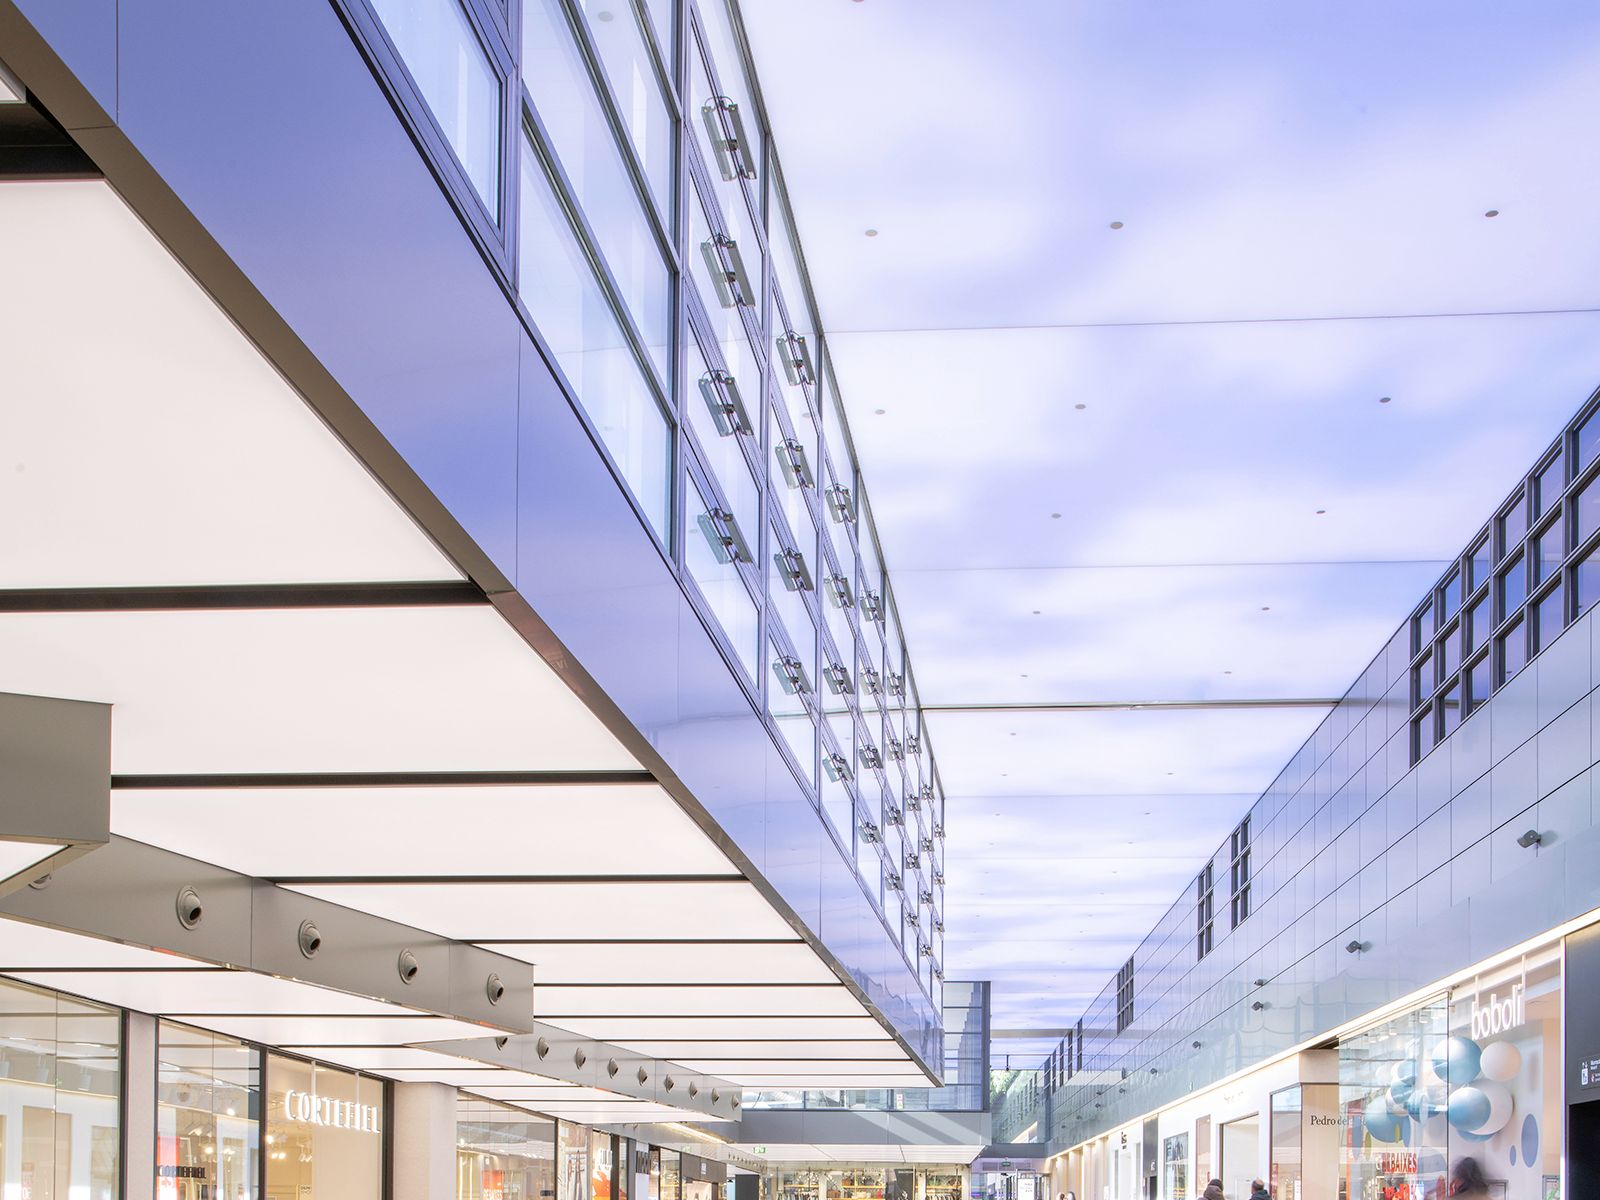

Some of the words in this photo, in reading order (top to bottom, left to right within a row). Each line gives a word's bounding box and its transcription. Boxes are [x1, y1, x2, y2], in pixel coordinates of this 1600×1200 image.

[1472, 984, 1525, 1041] boboli
[285, 1089, 381, 1134] CORTEFIEL
[1311, 1115, 1336, 1126] Pedro
